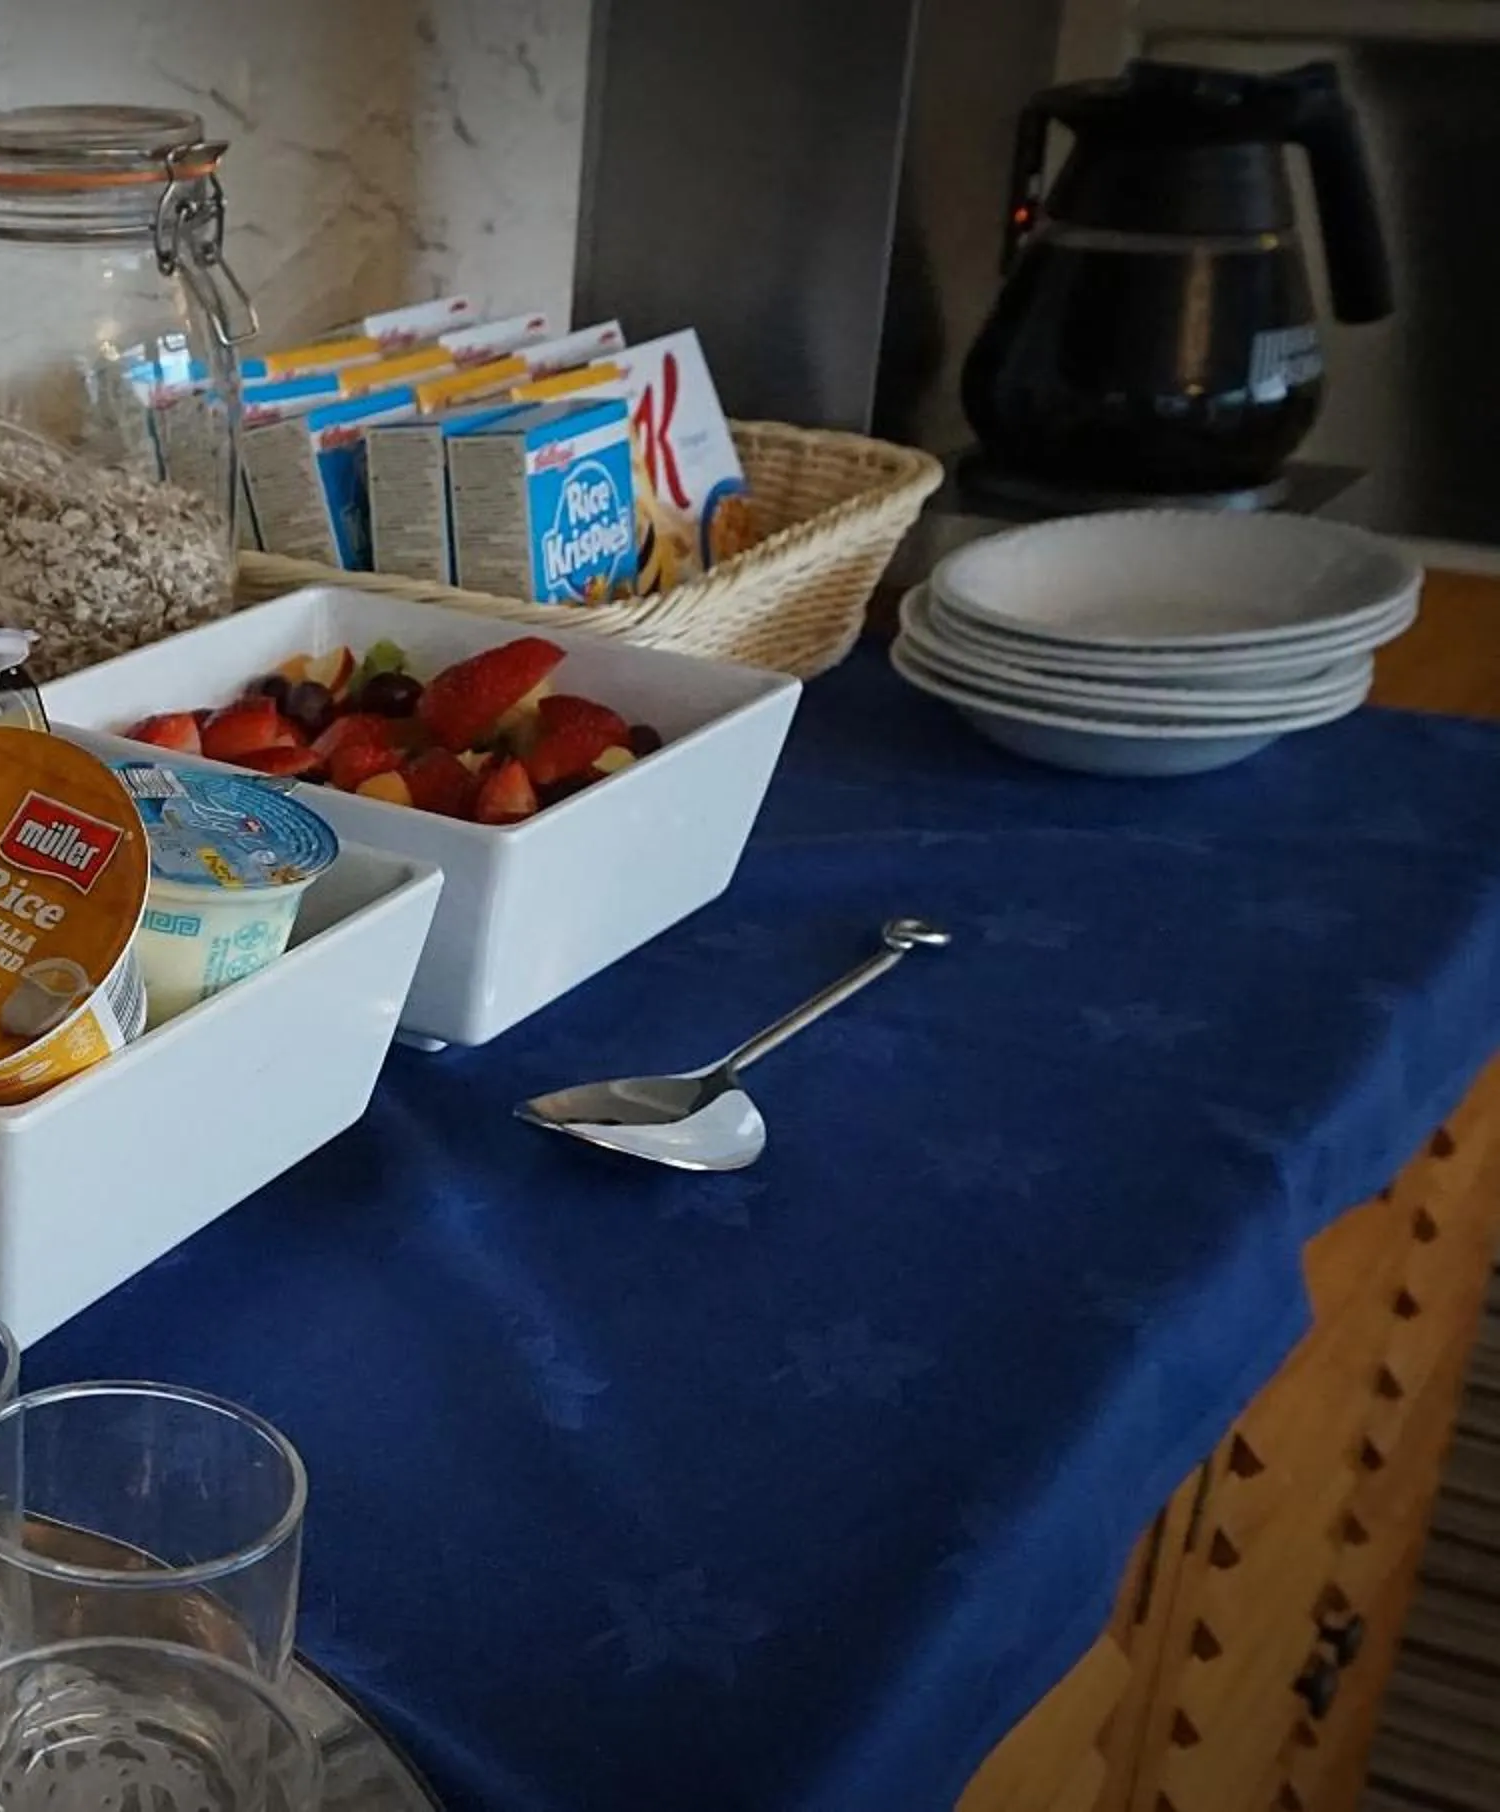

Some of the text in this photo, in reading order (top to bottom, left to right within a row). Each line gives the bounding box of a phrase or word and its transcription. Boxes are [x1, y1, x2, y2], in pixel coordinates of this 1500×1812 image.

[567, 480, 610, 525] Rice
[547, 508, 630, 580] Krispies
[15, 819, 100, 871] müller
